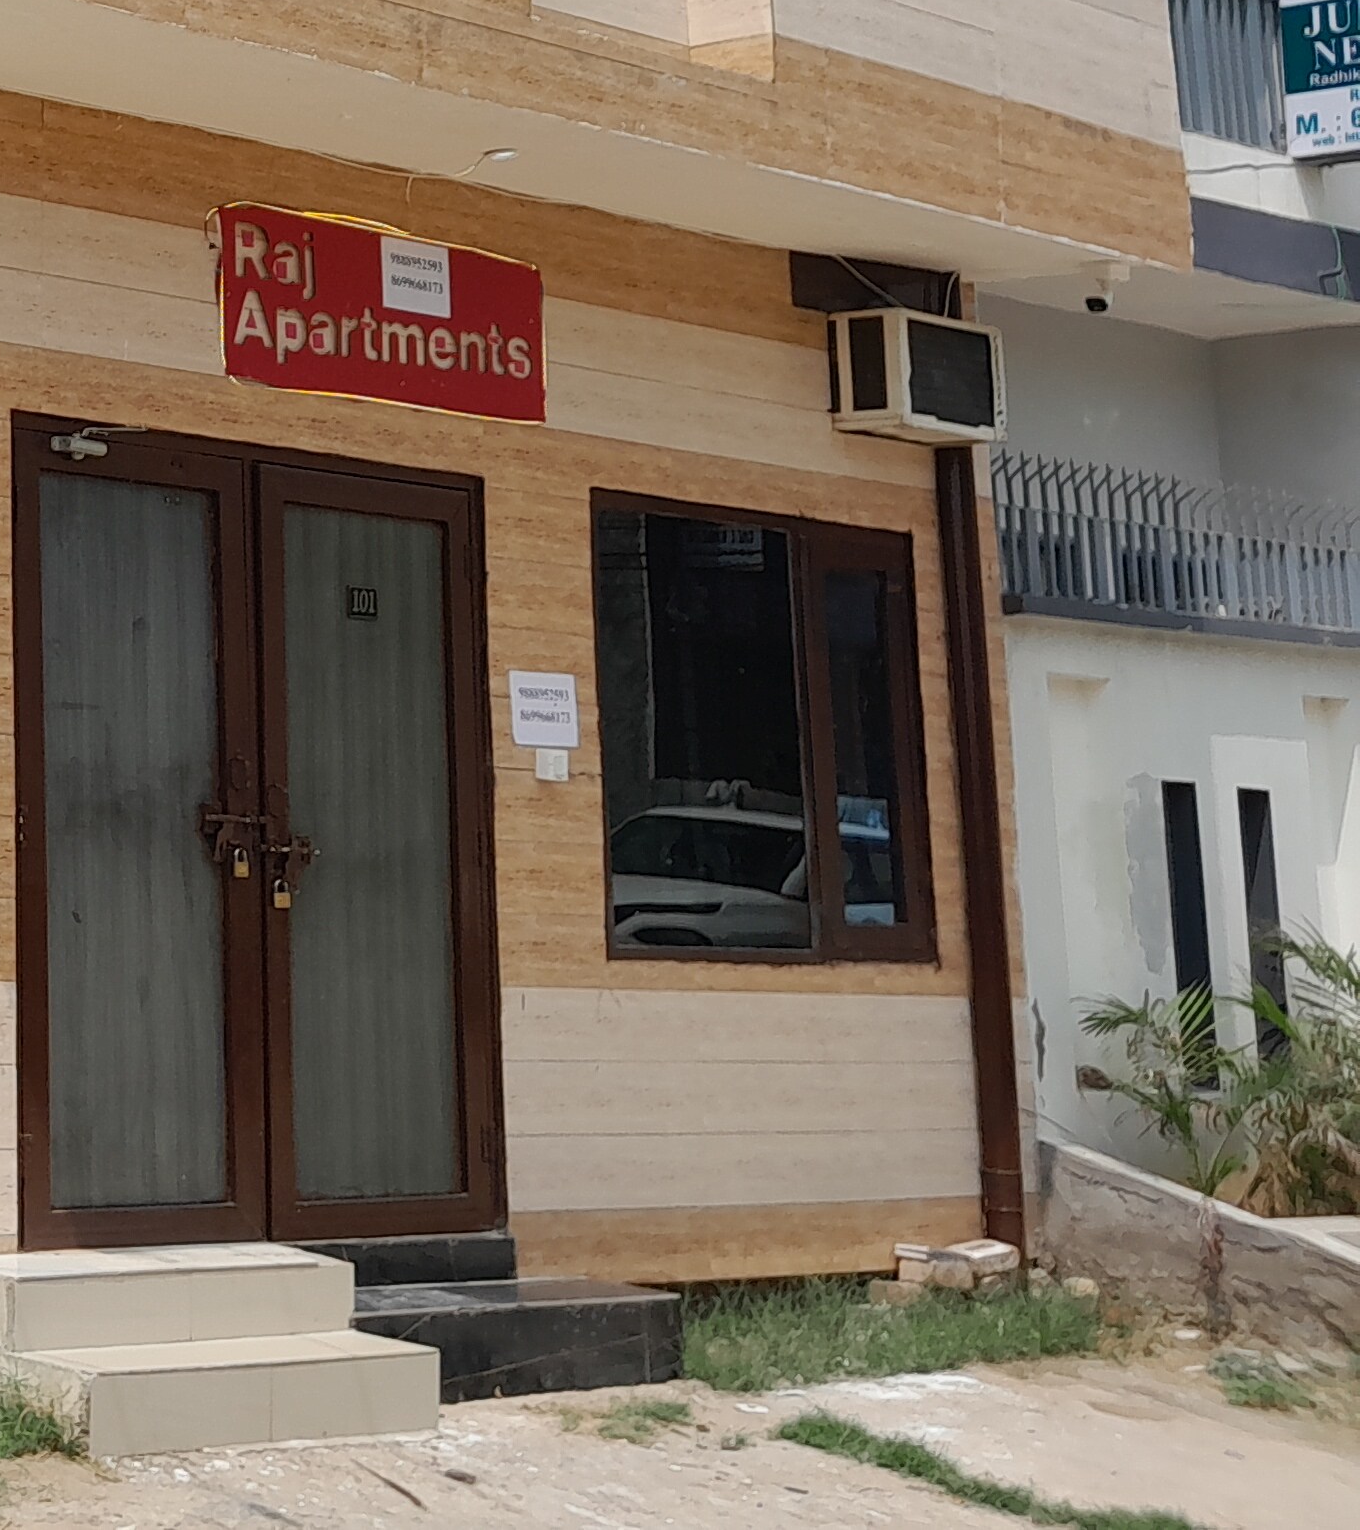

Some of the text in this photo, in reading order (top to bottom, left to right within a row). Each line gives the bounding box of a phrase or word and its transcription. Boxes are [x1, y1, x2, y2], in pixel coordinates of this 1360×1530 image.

[234, 221, 315, 301] Raj
[233, 290, 533, 380] Apartments
[352, 589, 376, 614] 101
